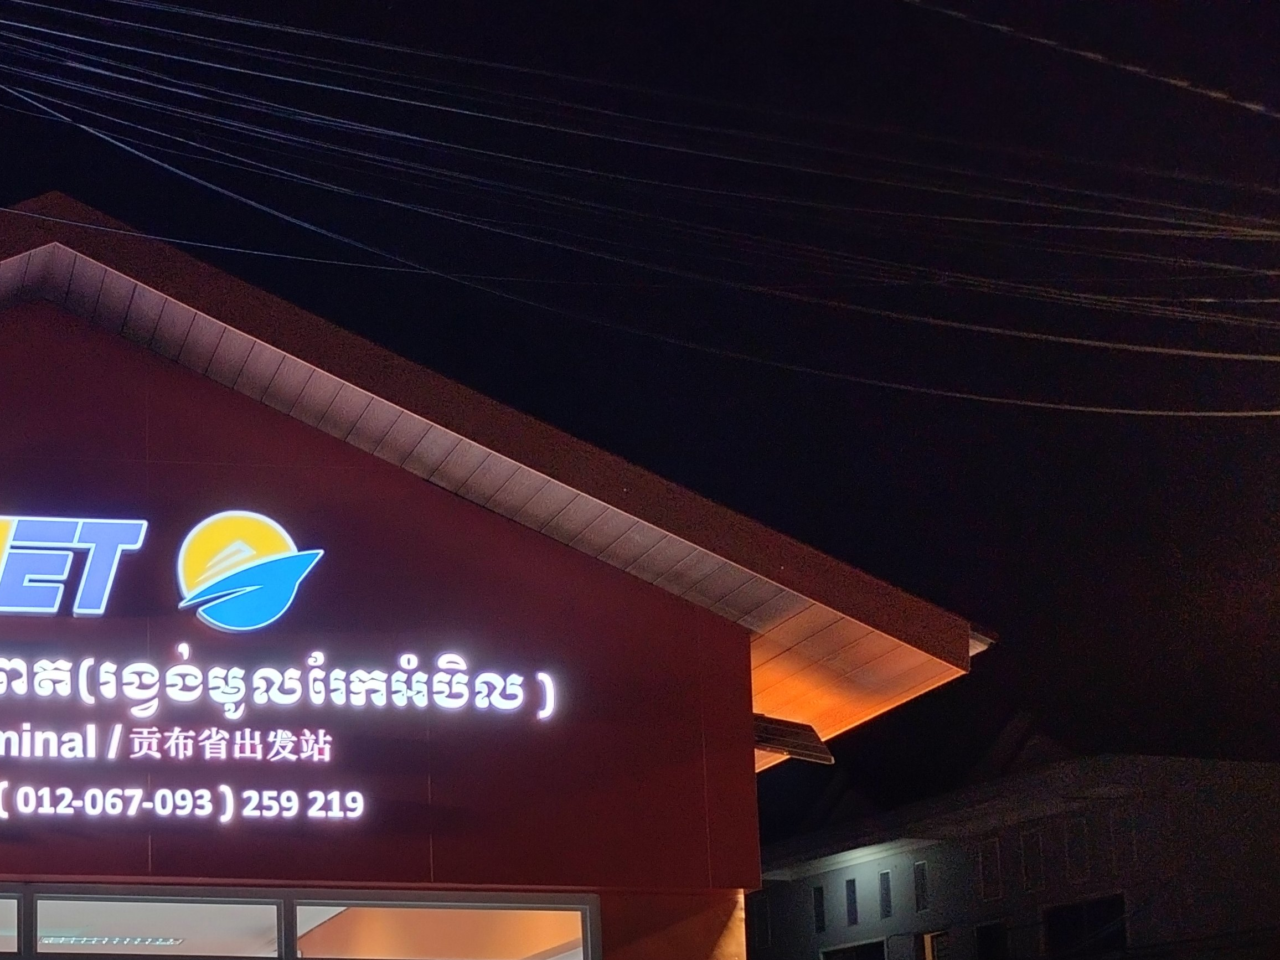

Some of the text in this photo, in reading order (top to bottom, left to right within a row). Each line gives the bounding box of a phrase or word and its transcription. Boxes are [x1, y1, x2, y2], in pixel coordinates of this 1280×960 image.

[129, 726, 332, 763] 贡布省出发站
[241, 789, 300, 819] 259
[307, 790, 364, 820] 219
